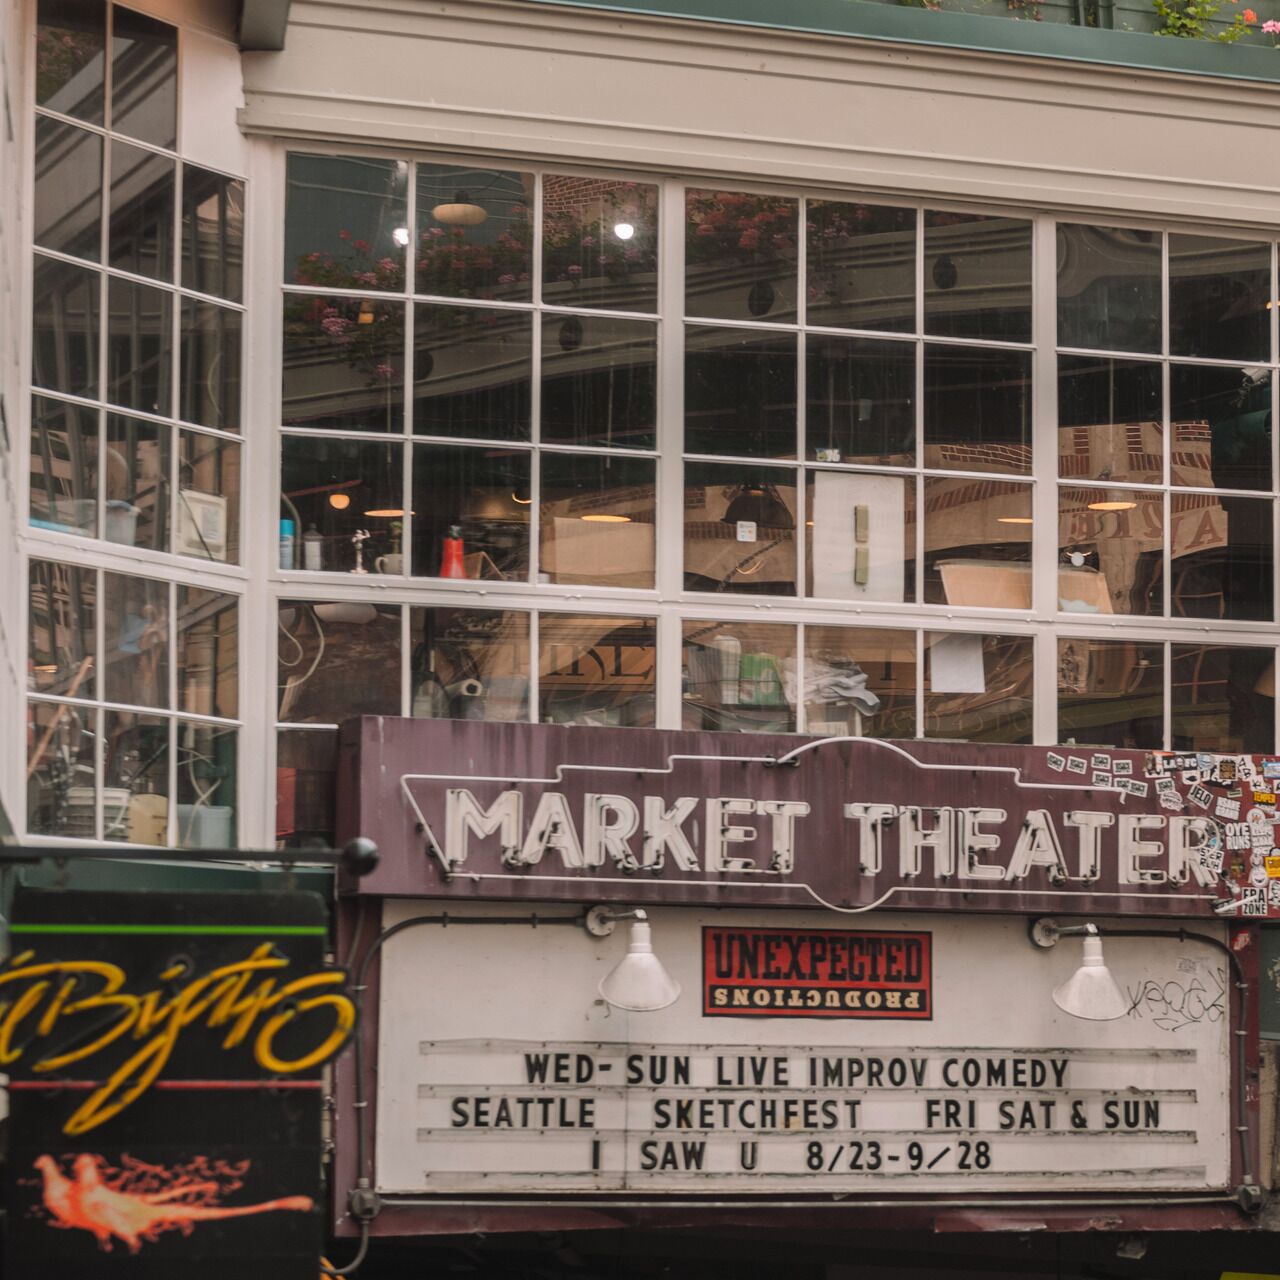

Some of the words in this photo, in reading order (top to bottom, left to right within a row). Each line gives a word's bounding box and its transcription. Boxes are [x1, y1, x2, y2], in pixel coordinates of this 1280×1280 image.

[446, 786, 810, 872] MARKET
[844, 802, 1222, 888] THEATER
[1225, 822, 1250, 836] OYE
[1243, 902, 1266, 915] ZONE
[713, 932, 924, 983] UNEXPECTED
[715, 987, 920, 1009] PRODUCTIONS
[626, 1054, 690, 1085] SUN
[717, 1056, 789, 1086] LIVE
[809, 1057, 928, 1087] IMPROV
[942, 1058, 1068, 1088] COMEDY
[451, 1097, 595, 1128] SEATTLE
[653, 1098, 861, 1129] SKETCHFEST
[926, 1099, 976, 1128] FRI
[998, 1100, 1057, 1128] SAT
[1070, 1100, 1089, 1129] &
[1103, 1100, 1161, 1129] SUN
[592, 1140, 601, 1171] I
[640, 1140, 707, 1171] SAW
[740, 1141, 758, 1171] U
[806, 1140, 992, 1172] 8/23-9/28
